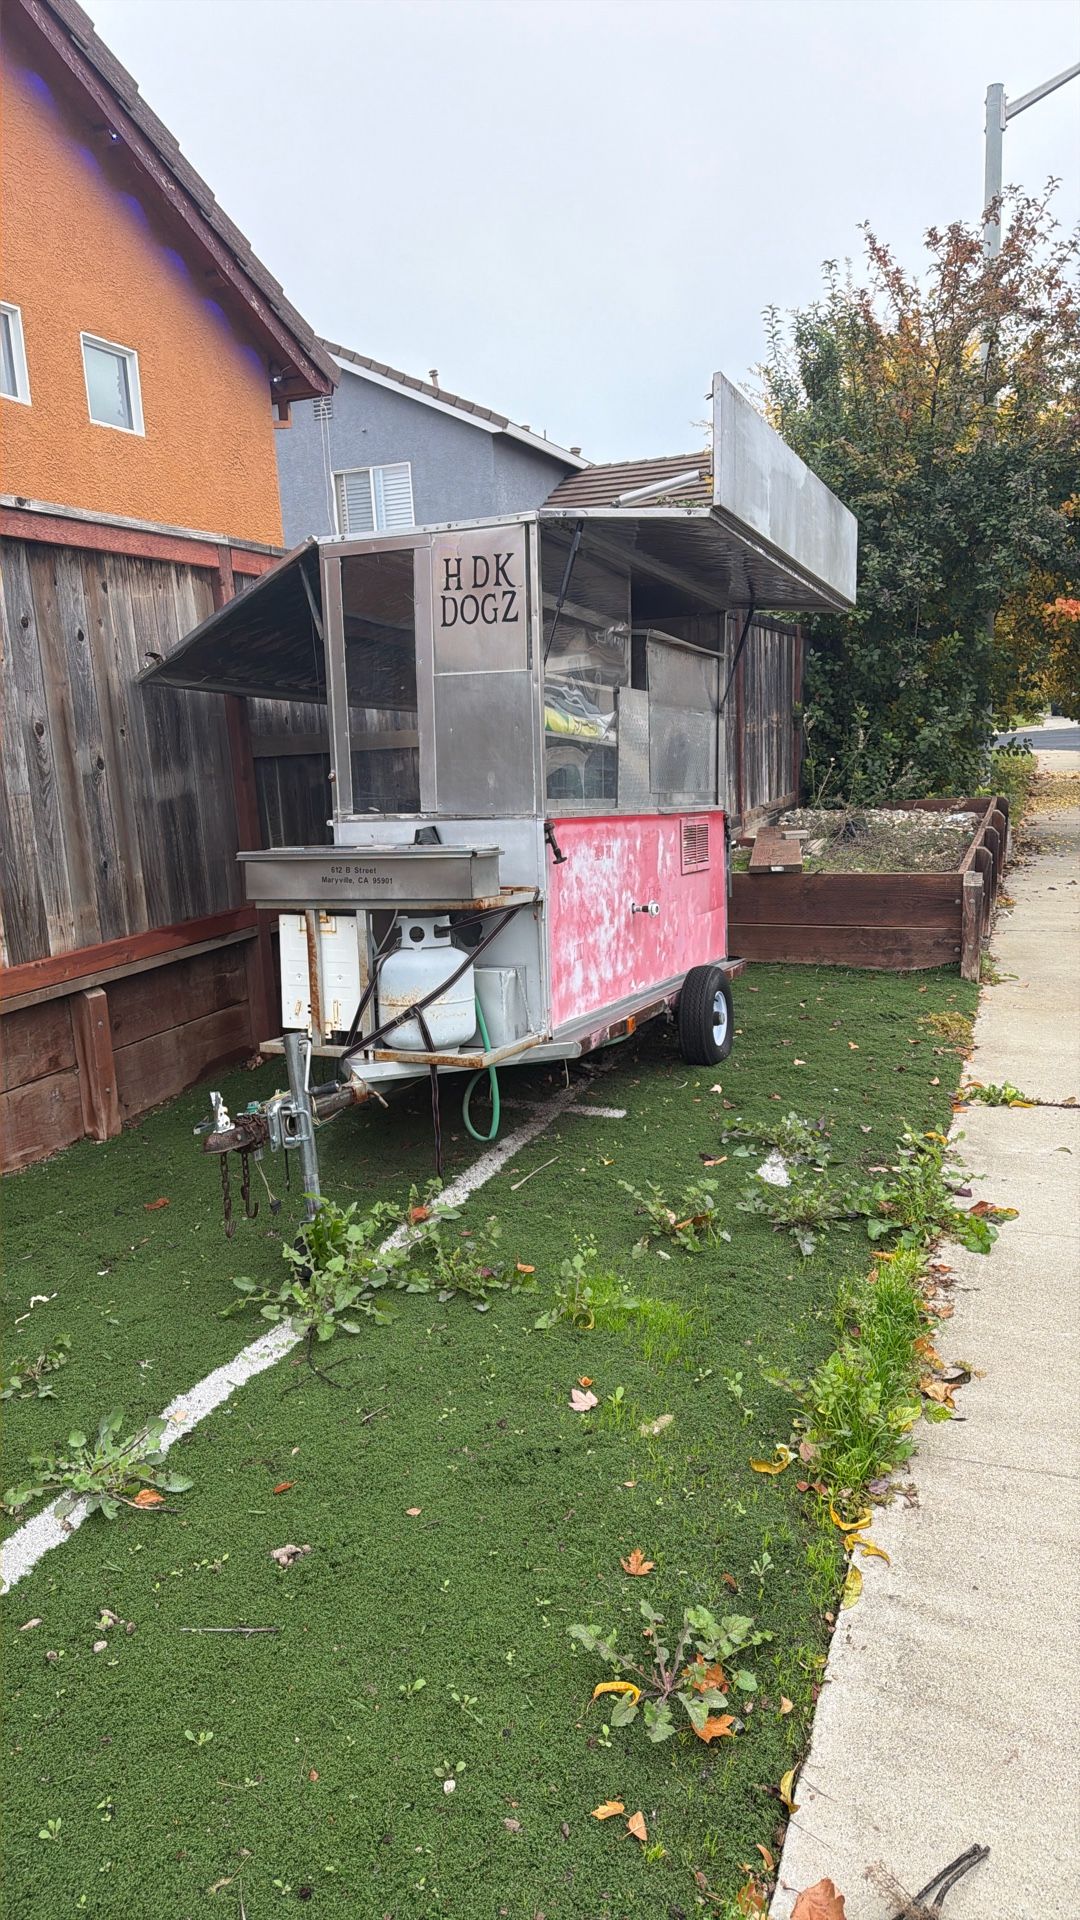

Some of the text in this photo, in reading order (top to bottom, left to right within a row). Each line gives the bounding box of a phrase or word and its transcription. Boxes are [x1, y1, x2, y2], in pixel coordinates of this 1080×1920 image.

[440, 590, 519, 627] DOGZ
[330, 866, 377, 874] 612 B Street
[321, 876, 355, 885] Maryville,
[358, 876, 369, 884] CA
